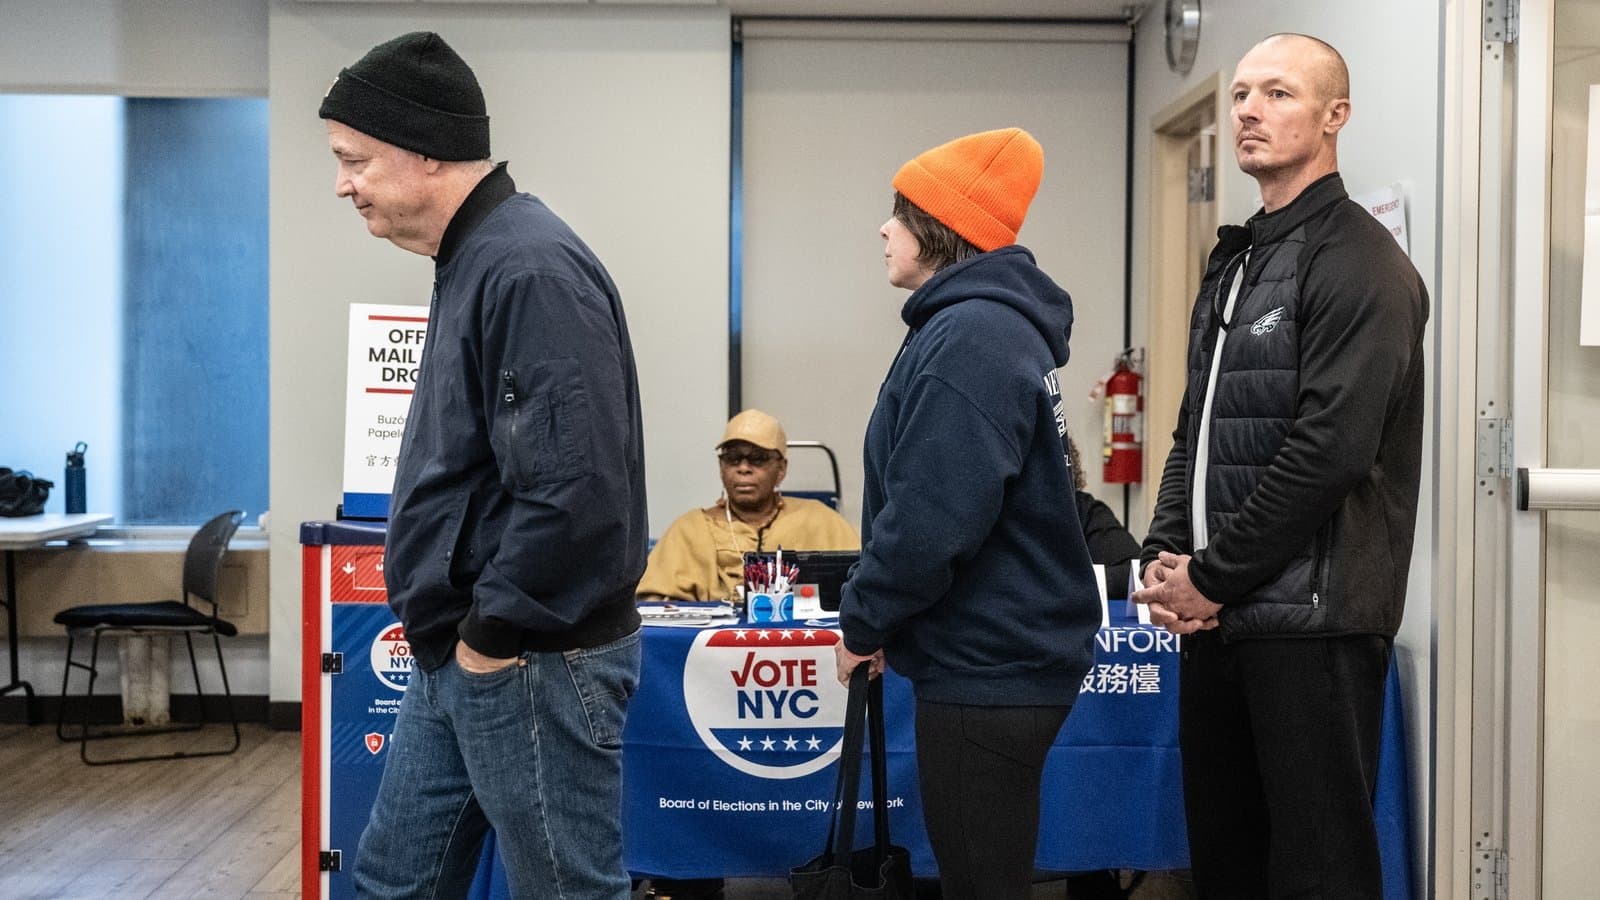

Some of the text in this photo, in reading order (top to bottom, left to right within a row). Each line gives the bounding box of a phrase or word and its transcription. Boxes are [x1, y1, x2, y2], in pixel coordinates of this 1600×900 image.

[368, 347, 417, 363] MAIL
[1094, 630, 1181, 653] NFOR
[730, 651, 817, 687] VOTE
[368, 706, 376, 714] in
[375, 698, 396, 706] Board
[737, 689, 819, 719] NYC
[659, 797, 695, 809] Board
[698, 799, 710, 810] of
[713, 800, 766, 812] Elections
[768, 800, 779, 811] in
[782, 799, 802, 811] the
[805, 799, 830, 812] City
[857, 799, 874, 810] ew
[886, 797, 905, 809] ork
